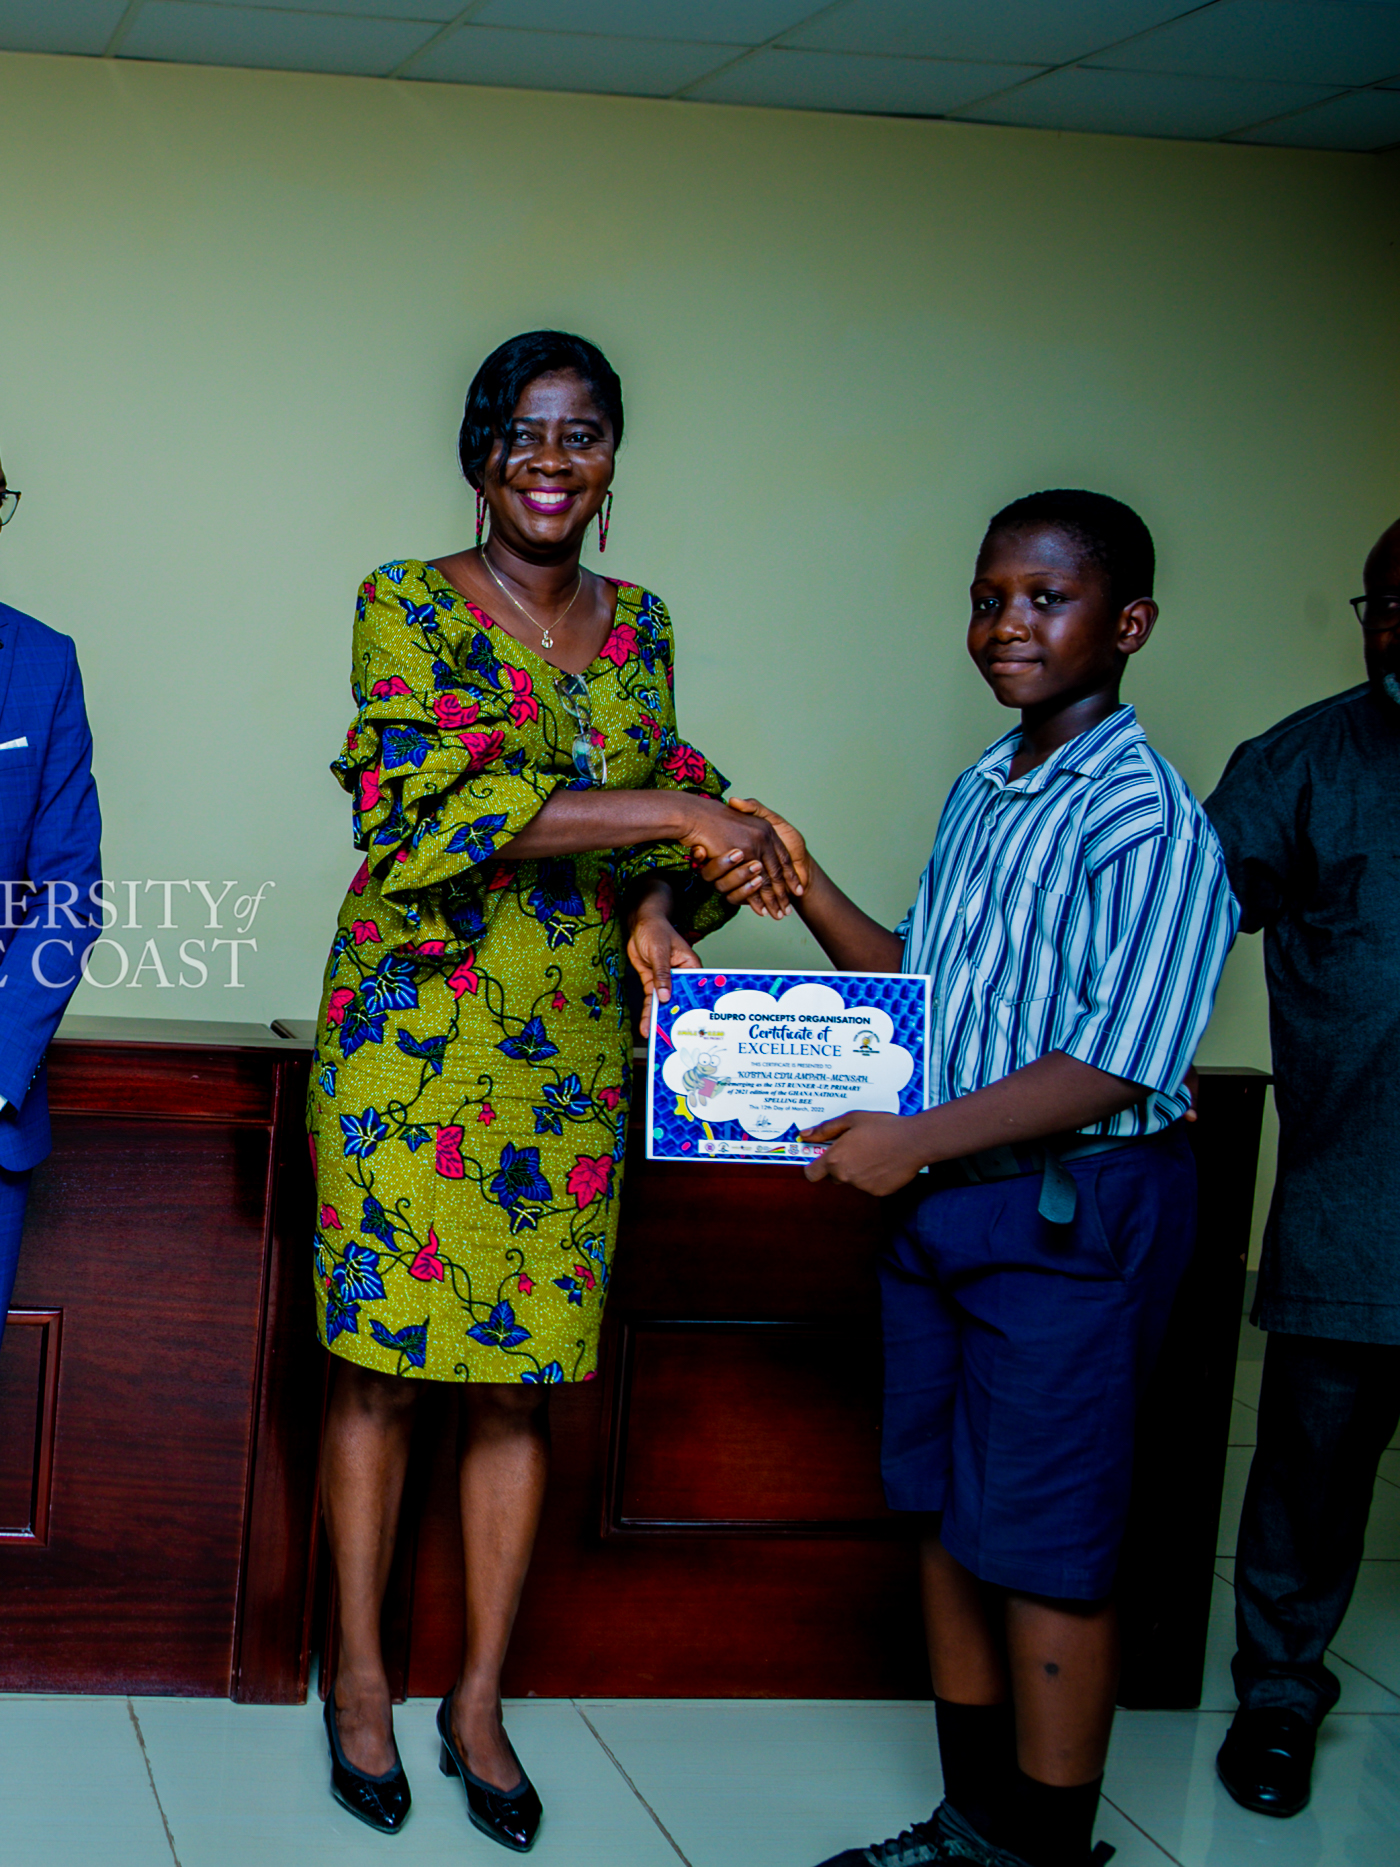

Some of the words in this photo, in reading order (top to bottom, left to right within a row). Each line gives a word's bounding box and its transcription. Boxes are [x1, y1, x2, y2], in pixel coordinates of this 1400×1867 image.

[709, 1013, 746, 1021] EDUPRO
[748, 1014, 796, 1022] CONCEPTS
[798, 1014, 871, 1025] ORGANISATION
[749, 1024, 813, 1041] Certificate
[817, 1026, 833, 1043] of
[738, 1042, 842, 1057] EXCELLENCE
